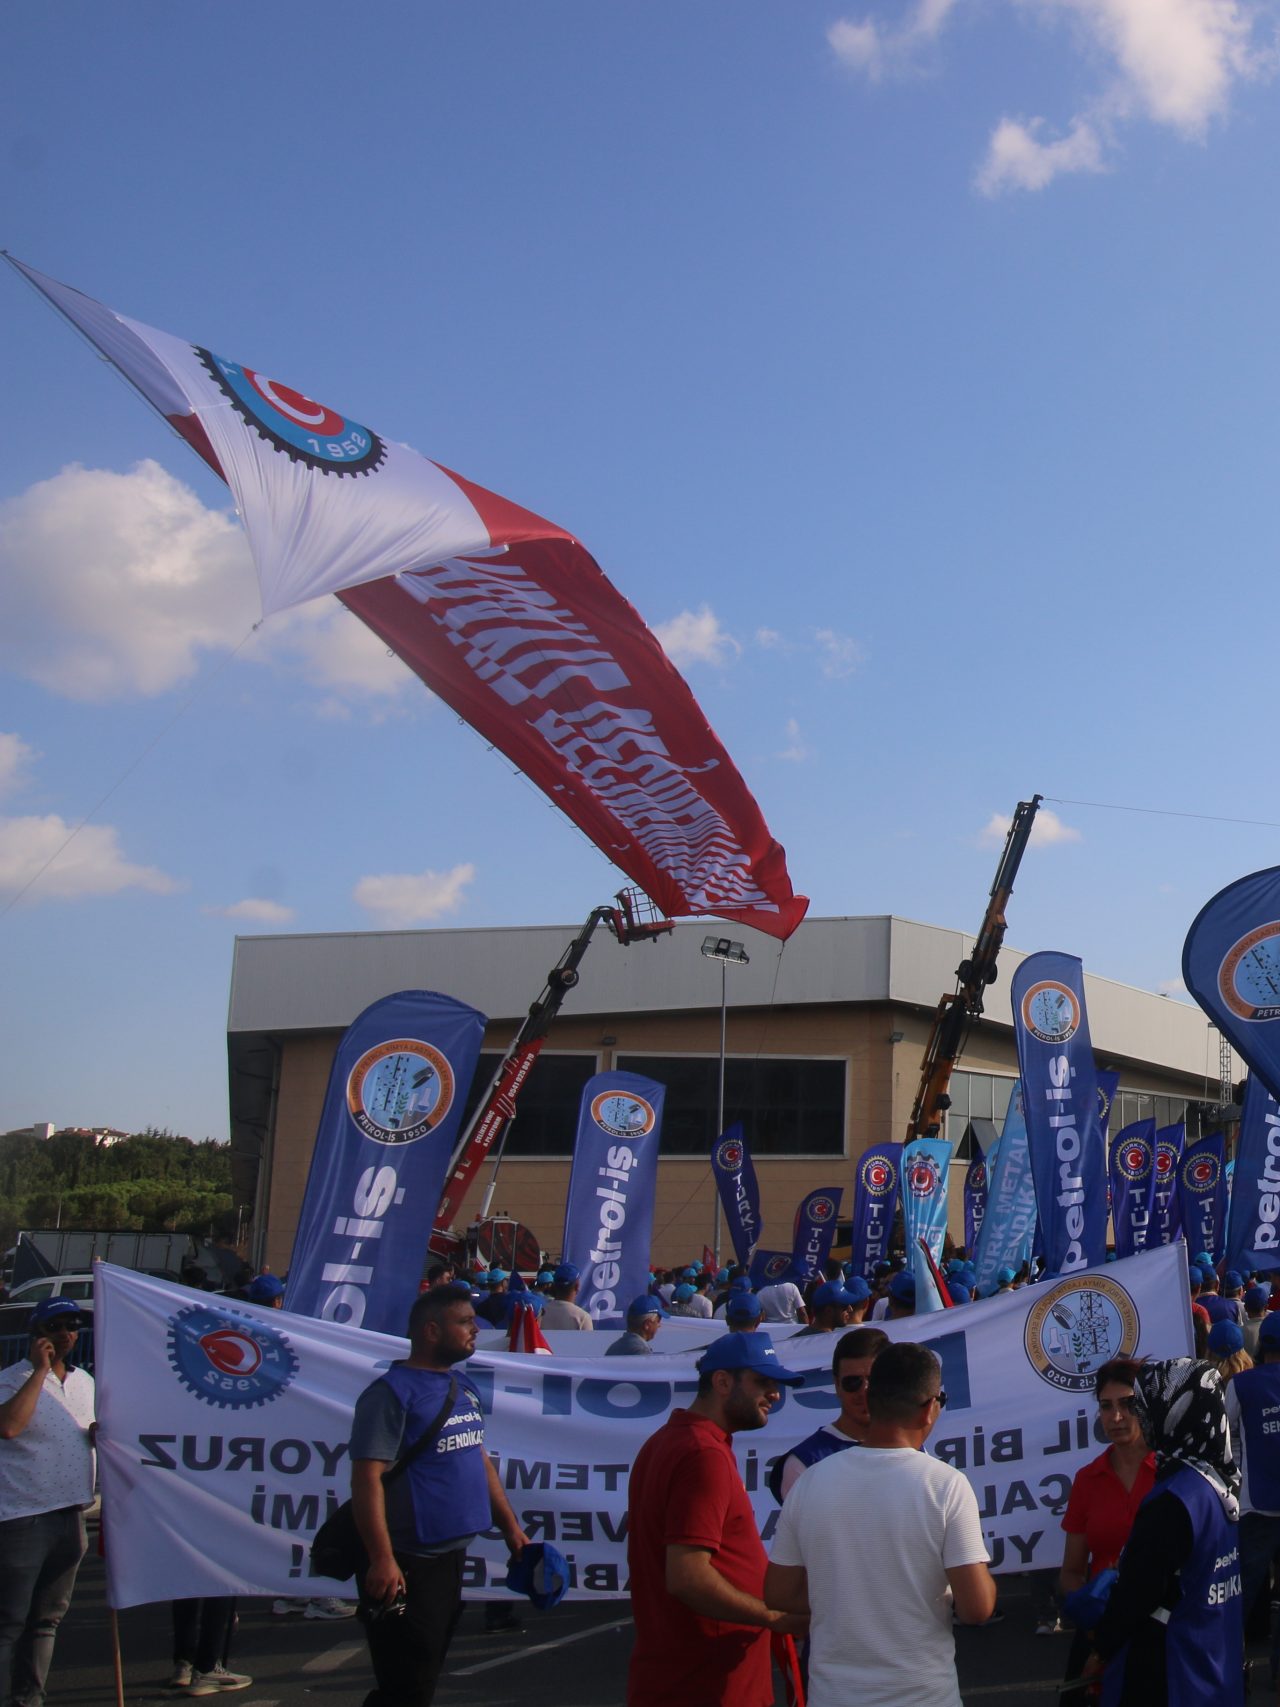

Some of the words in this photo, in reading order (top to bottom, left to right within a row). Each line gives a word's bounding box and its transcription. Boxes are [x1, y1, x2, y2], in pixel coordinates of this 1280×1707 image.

[357, 1113, 397, 1143] PETROL-İŞ
[402, 1124, 428, 1141] 1950
[320, 1165, 406, 1329] ol-iş
[589, 1145, 642, 1321] petrol-iş
[863, 1202, 885, 1279] TÜRK
[436, 1428, 484, 1454] SENDİKAS
